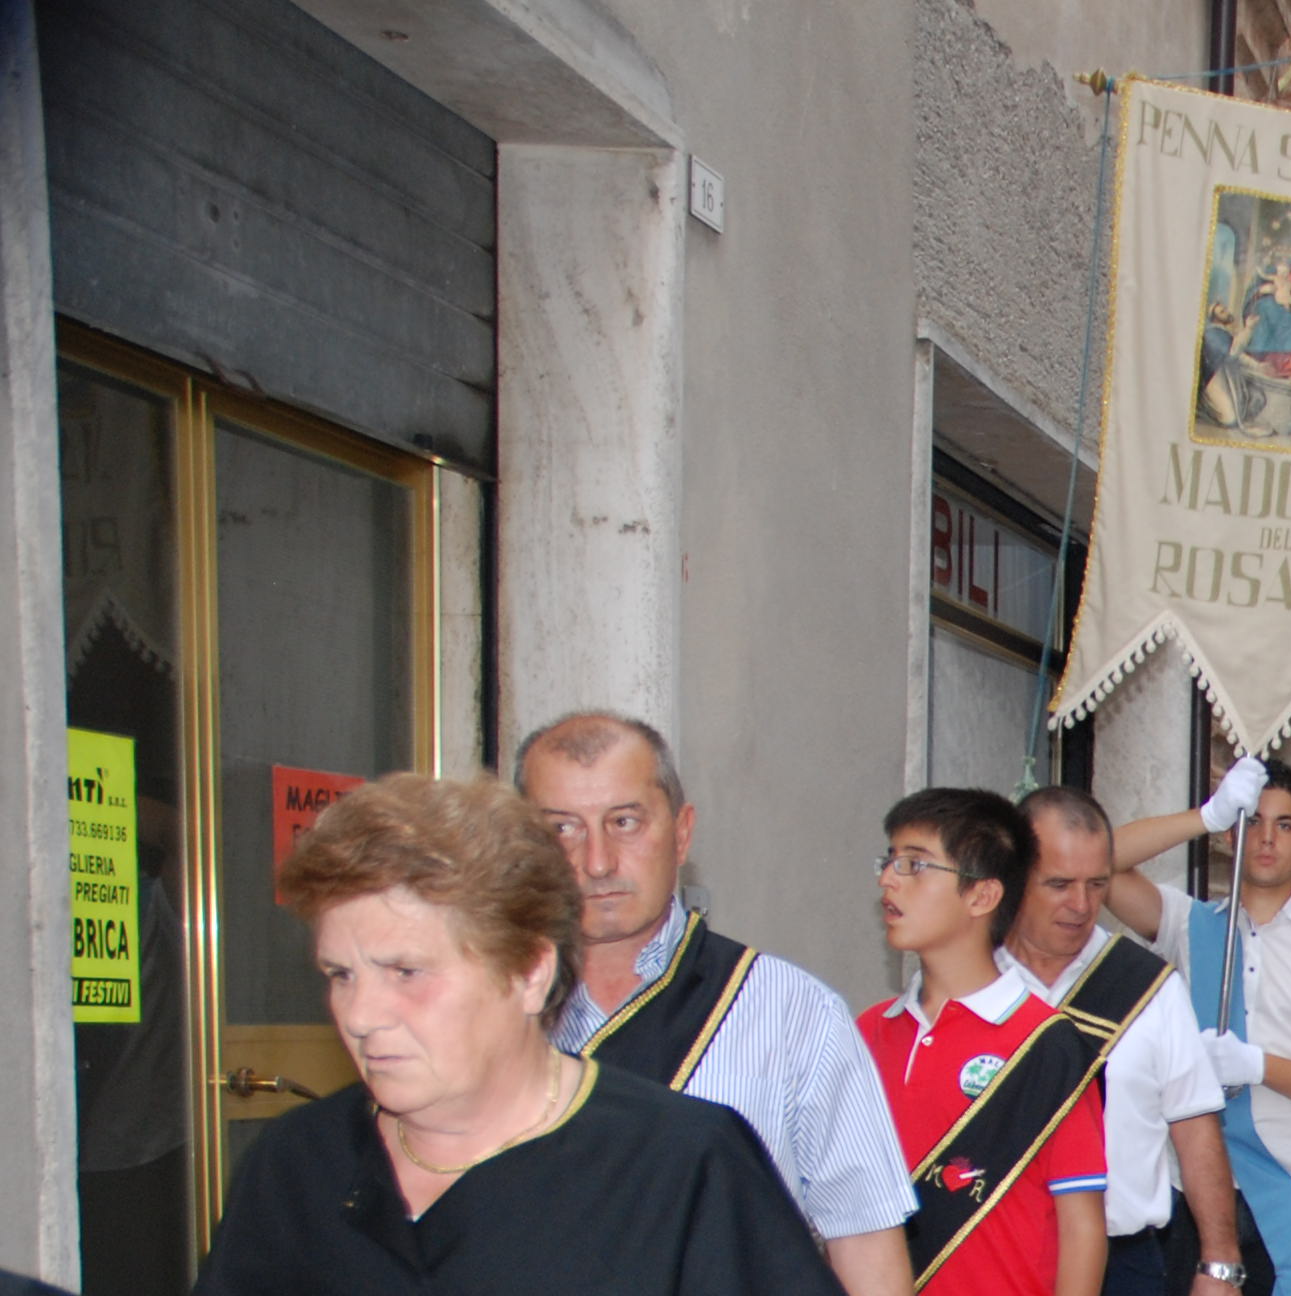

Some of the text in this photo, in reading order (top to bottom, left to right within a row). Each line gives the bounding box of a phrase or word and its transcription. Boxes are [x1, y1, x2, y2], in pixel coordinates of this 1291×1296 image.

[1136, 101, 1260, 174] PENNA
[702, 179, 714, 213] 16
[75, 881, 130, 905] PREGIATI
[73, 917, 130, 961] BRICA
[81, 980, 130, 1005] FESTIVI
